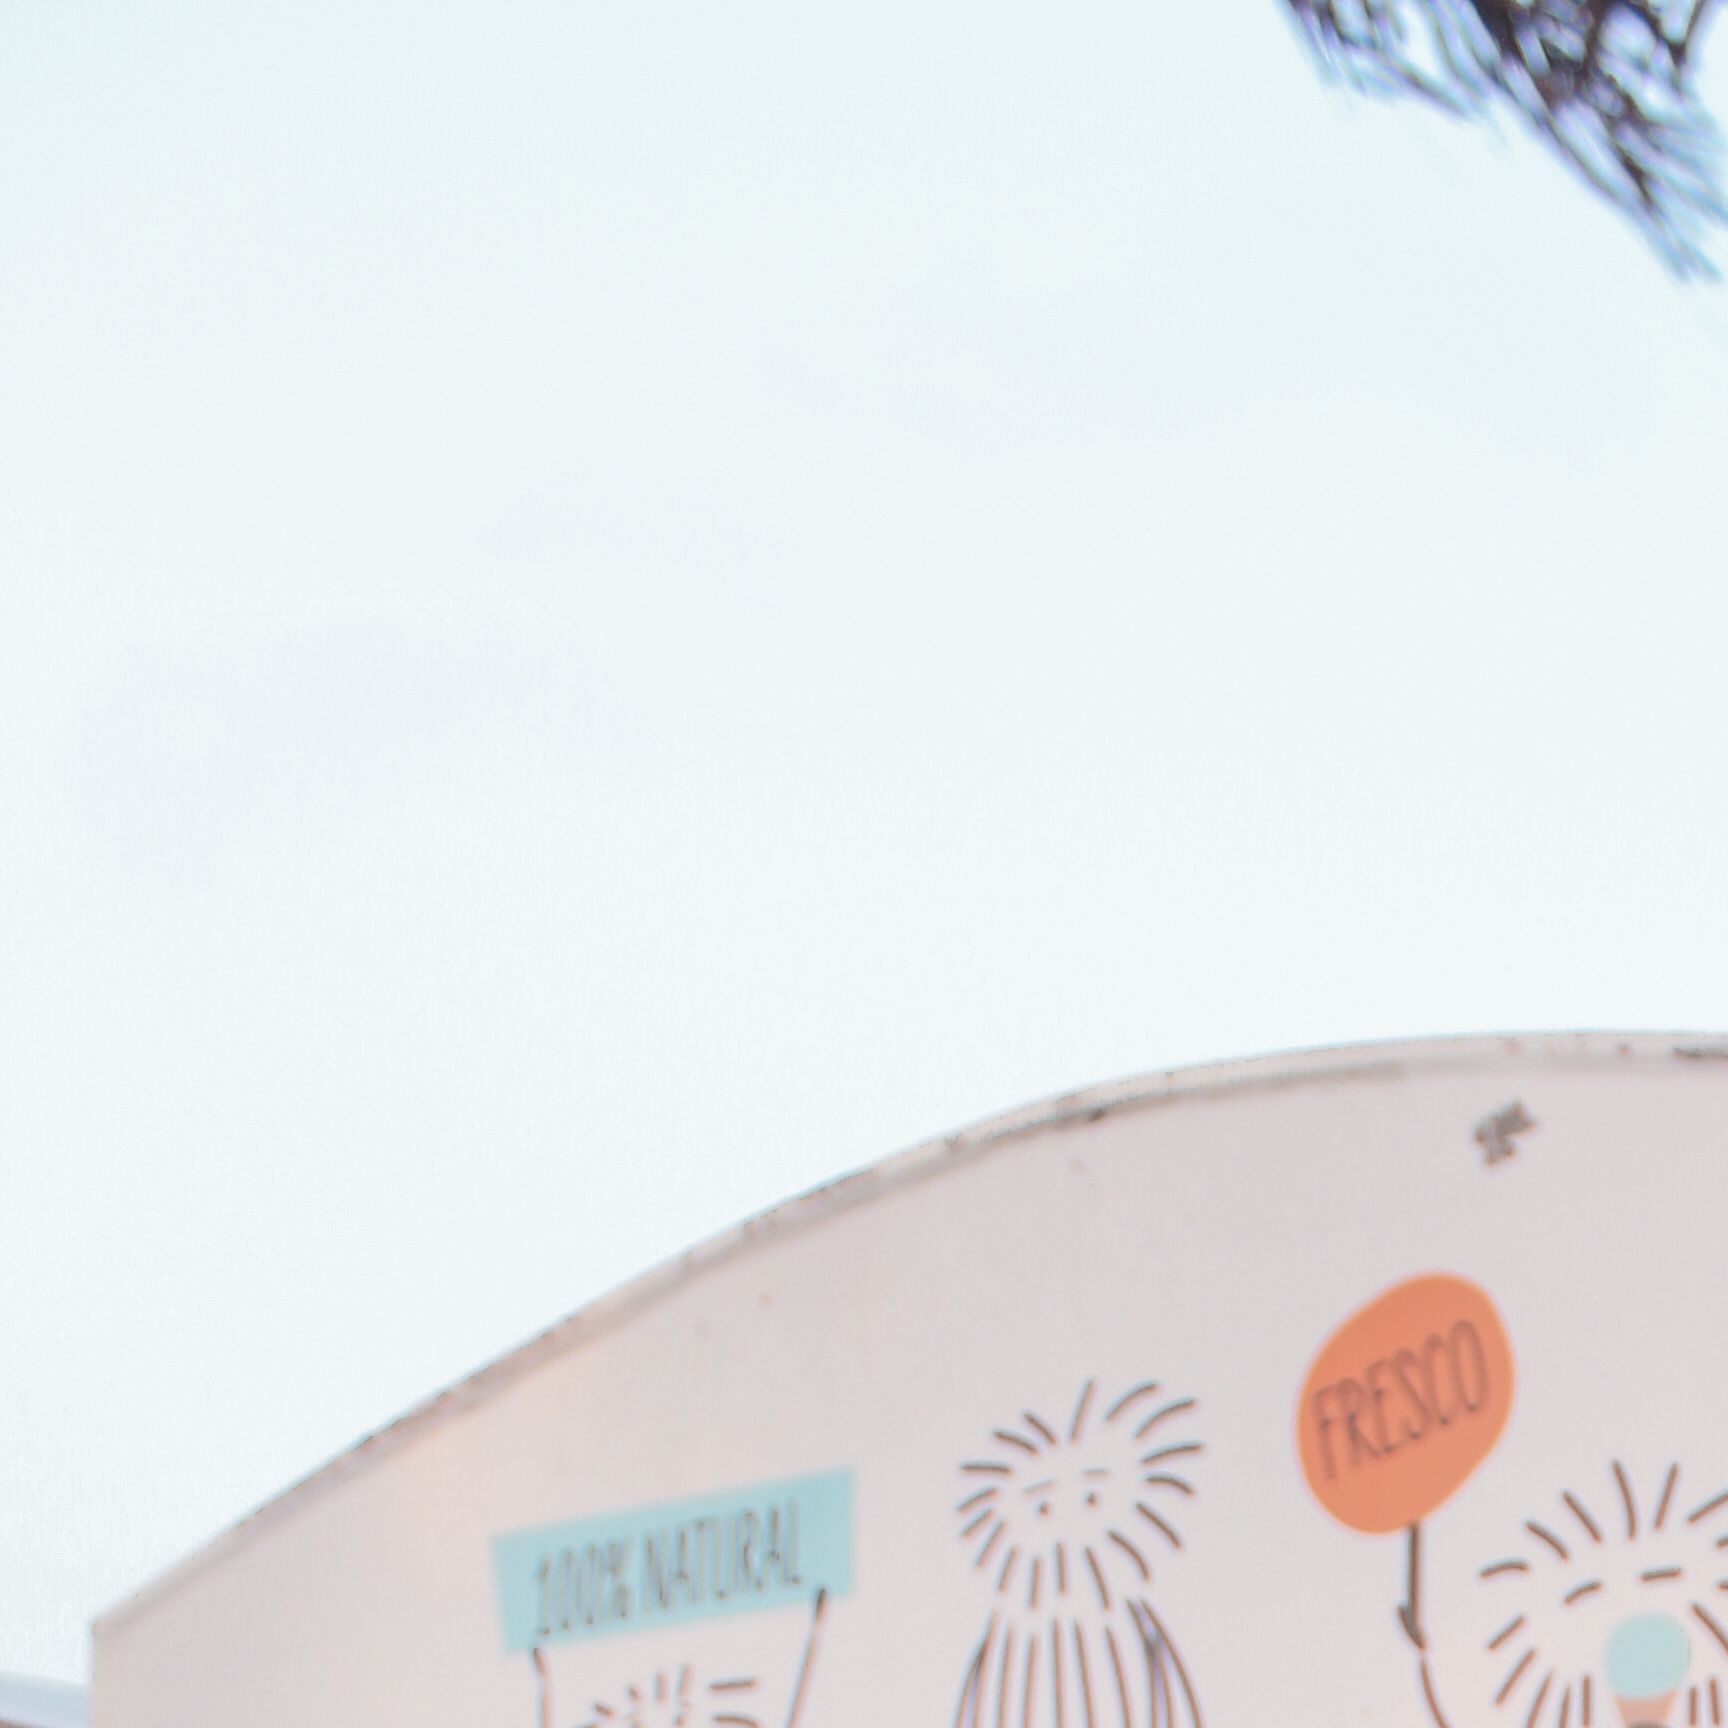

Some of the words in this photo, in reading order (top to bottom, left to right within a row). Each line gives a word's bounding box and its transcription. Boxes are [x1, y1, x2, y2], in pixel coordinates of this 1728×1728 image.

[1311, 1318, 1490, 1482] FRESCO
[534, 1536, 637, 1637] 100%
[642, 1500, 804, 1612] NATURAL
